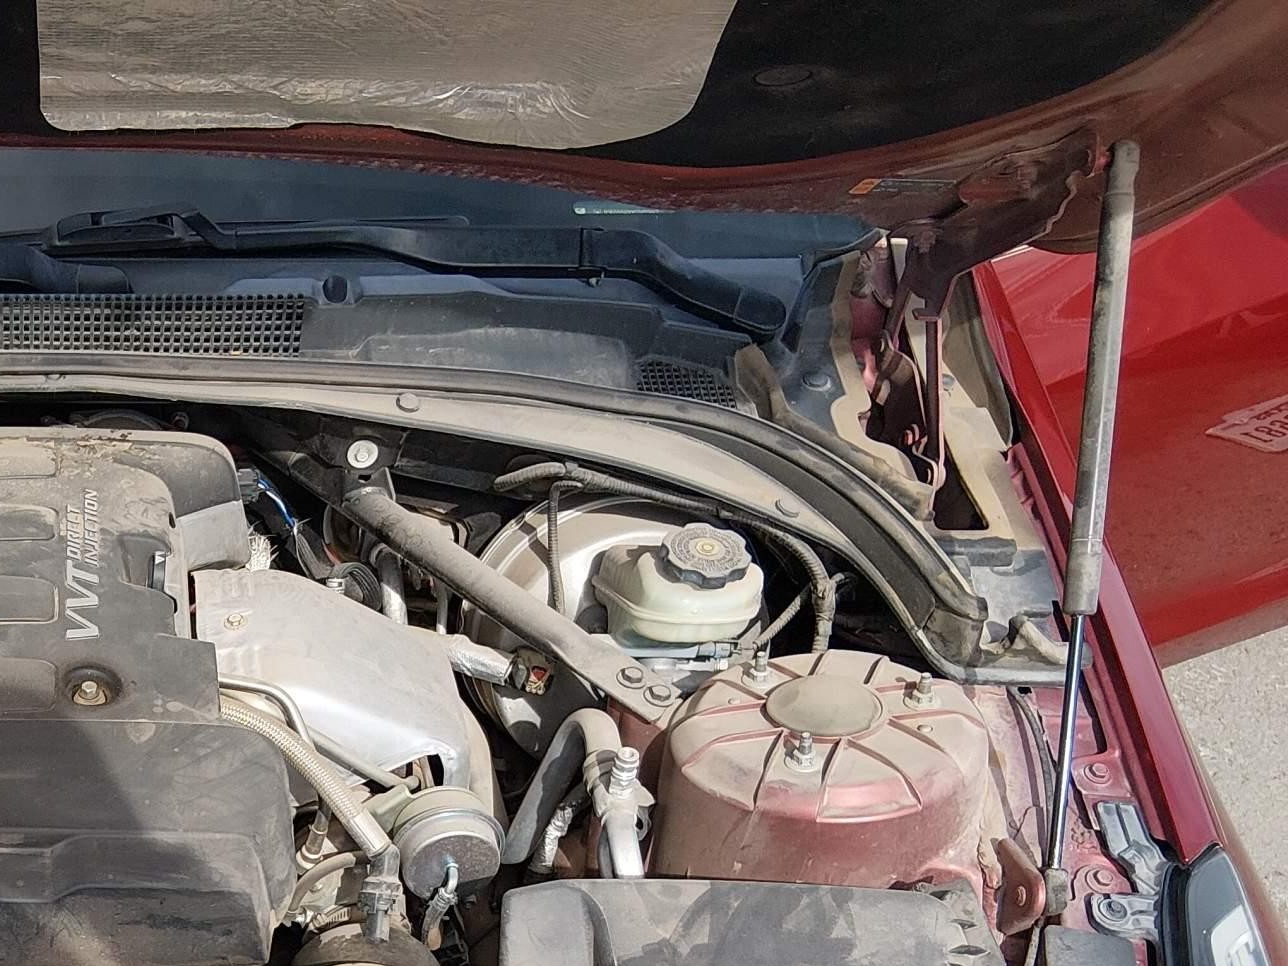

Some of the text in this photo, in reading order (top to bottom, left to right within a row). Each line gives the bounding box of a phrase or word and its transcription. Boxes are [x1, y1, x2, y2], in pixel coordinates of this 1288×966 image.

[66, 503, 82, 561] DIRECT
[84, 488, 100, 567] INJECTION
[65, 559, 100, 641] VVT
